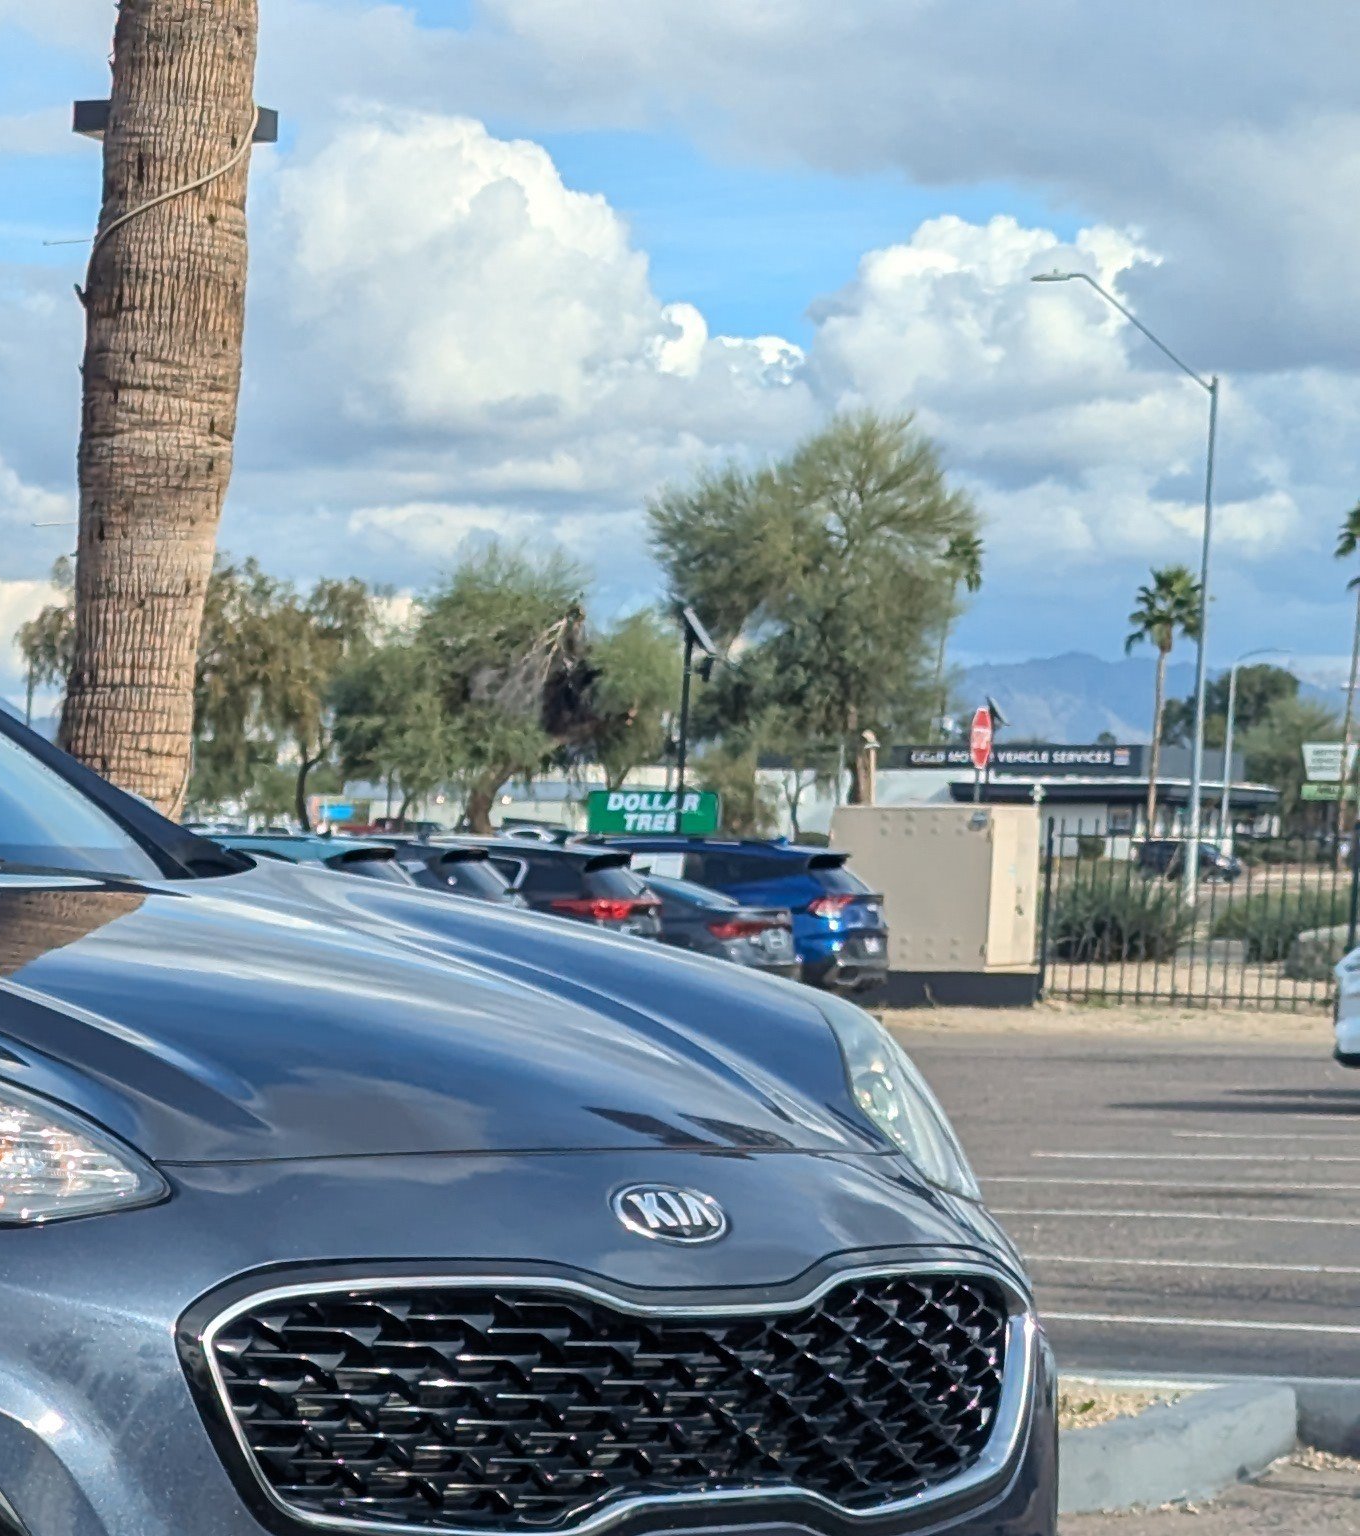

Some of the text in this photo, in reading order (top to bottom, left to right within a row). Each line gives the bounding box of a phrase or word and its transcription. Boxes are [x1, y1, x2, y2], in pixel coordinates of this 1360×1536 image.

[997, 751, 1049, 763] VEHICLE
[1052, 751, 1112, 764] SERVICES
[626, 1192, 719, 1228] KIA
